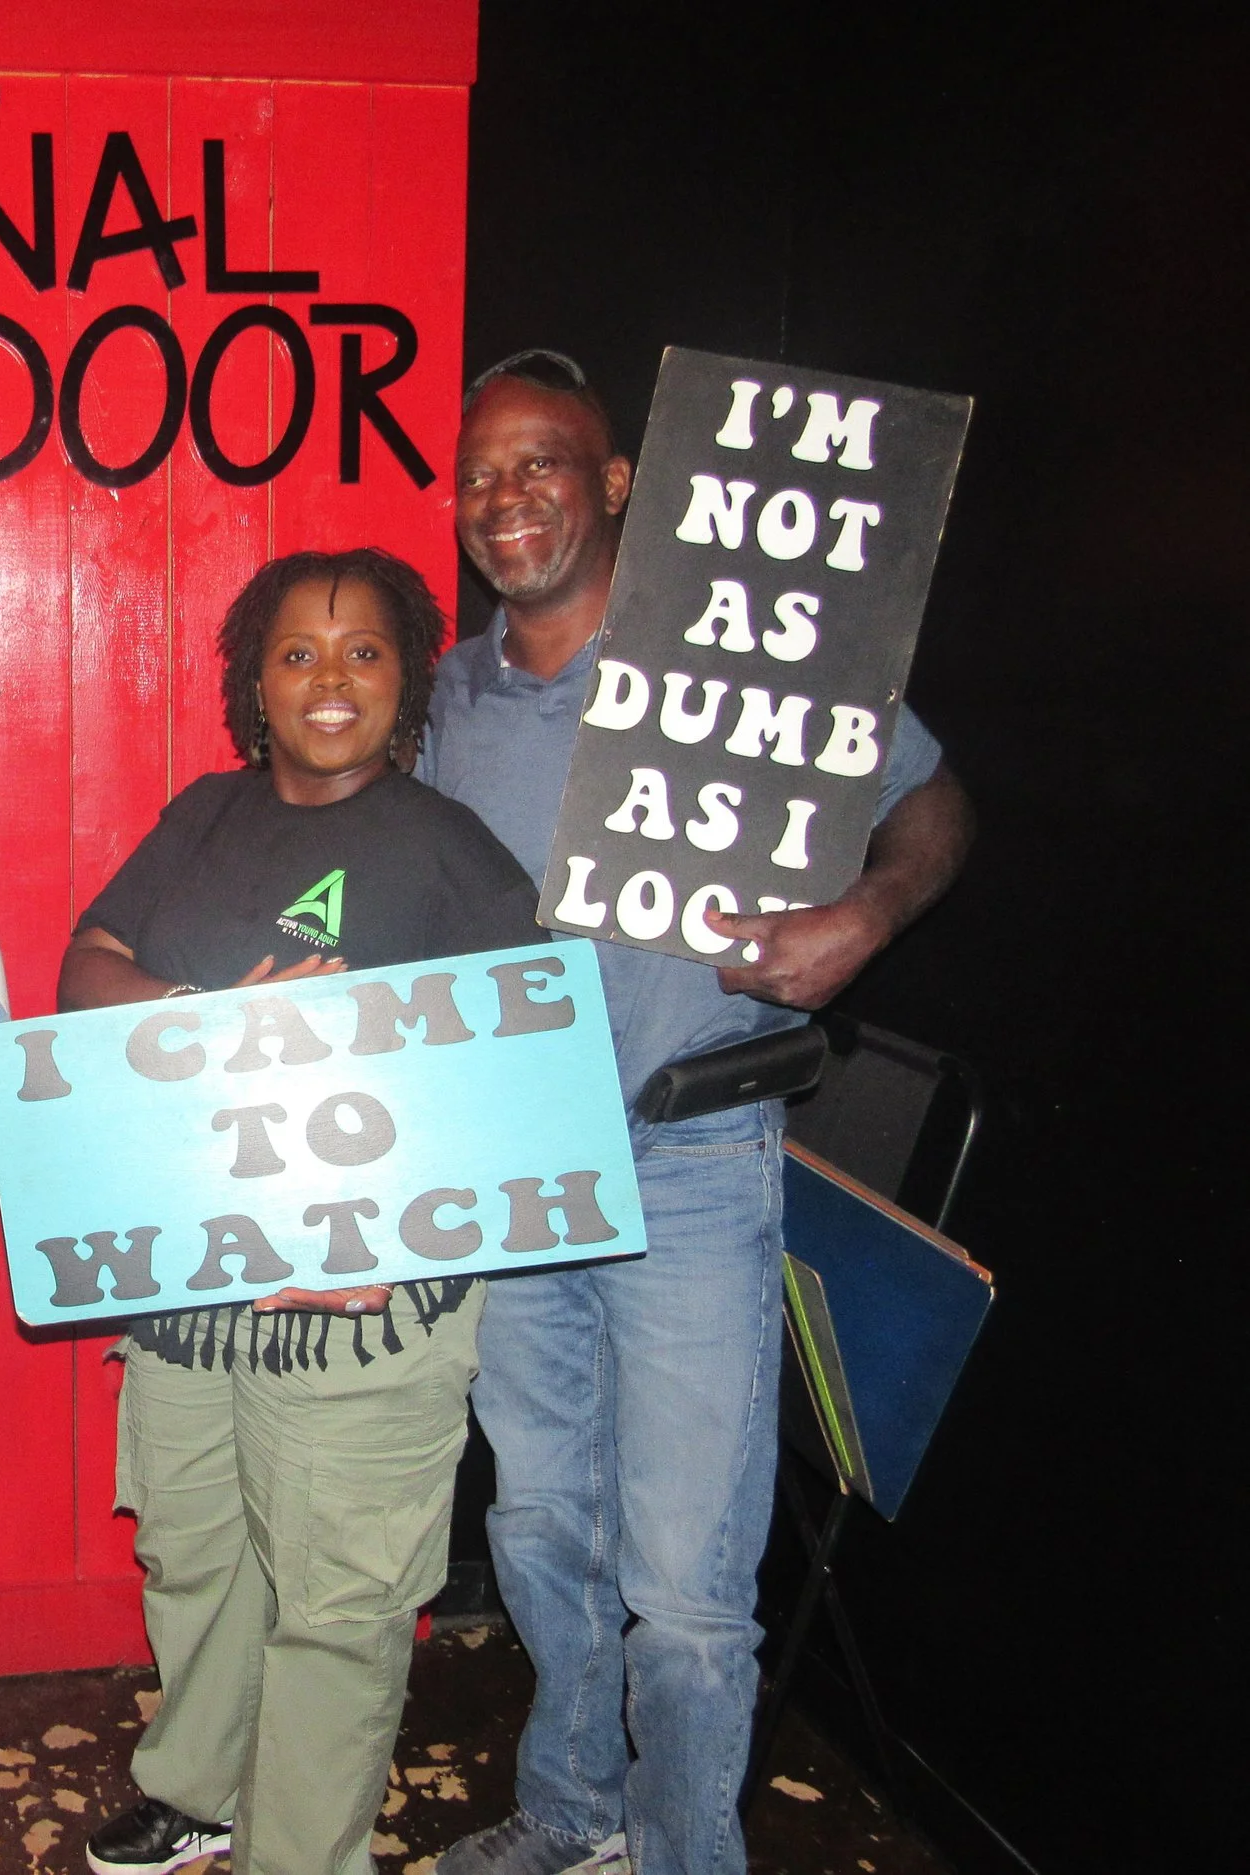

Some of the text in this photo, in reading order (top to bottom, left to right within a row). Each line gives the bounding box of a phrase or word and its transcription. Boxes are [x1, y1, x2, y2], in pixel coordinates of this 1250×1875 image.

[715, 380, 881, 470] I'M
[675, 474, 881, 572] NOT
[683, 580, 820, 662] AS
[582, 659, 880, 777] DUMB
[603, 767, 817, 870] AS I
[281, 927, 326, 949] MINISTRY
[318, 932, 339, 948] ADULT
[553, 855, 814, 963] LOO
[13, 956, 576, 1102] I CAME
[210, 1091, 397, 1180] TO
[34, 1170, 619, 1308] WATCH
